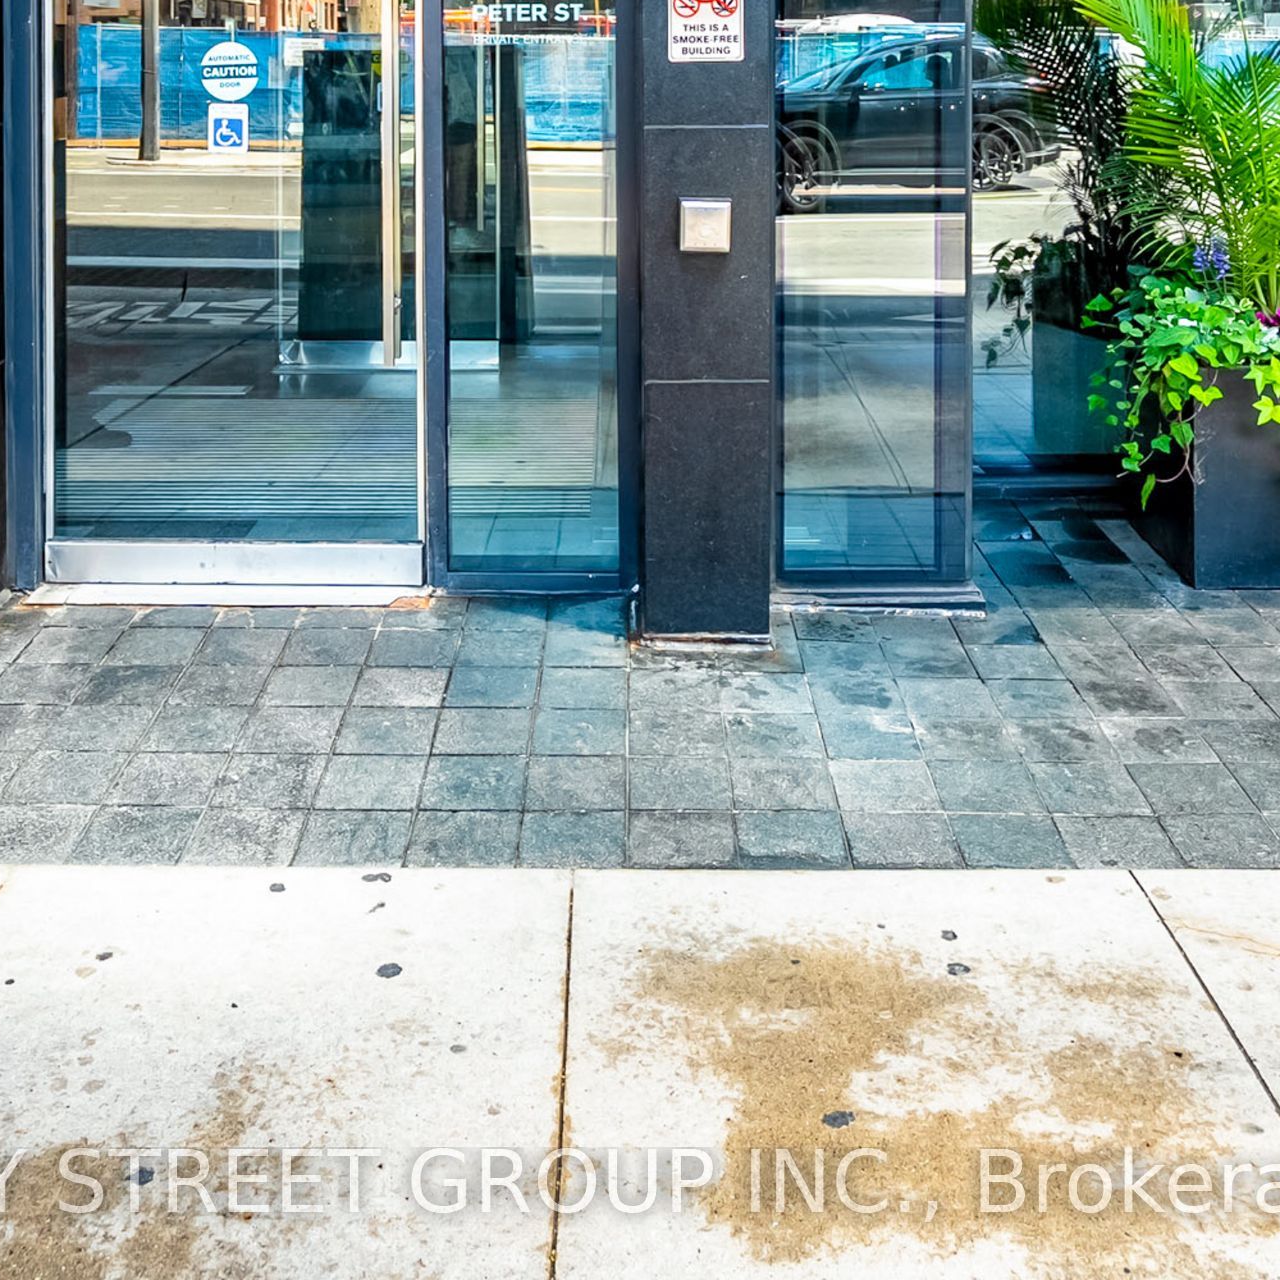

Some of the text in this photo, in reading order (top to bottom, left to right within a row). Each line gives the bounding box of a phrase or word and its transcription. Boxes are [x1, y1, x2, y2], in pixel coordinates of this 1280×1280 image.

[472, 4, 547, 22] PETER
[683, 24, 706, 32] THIS
[473, 34, 520, 45] PRIVATE
[673, 35, 739, 43] SMOKE-FREE
[682, 46, 731, 55] BUILDING
[208, 54, 250, 62] AUTOMATIC
[203, 66, 257, 78] CAUTION
